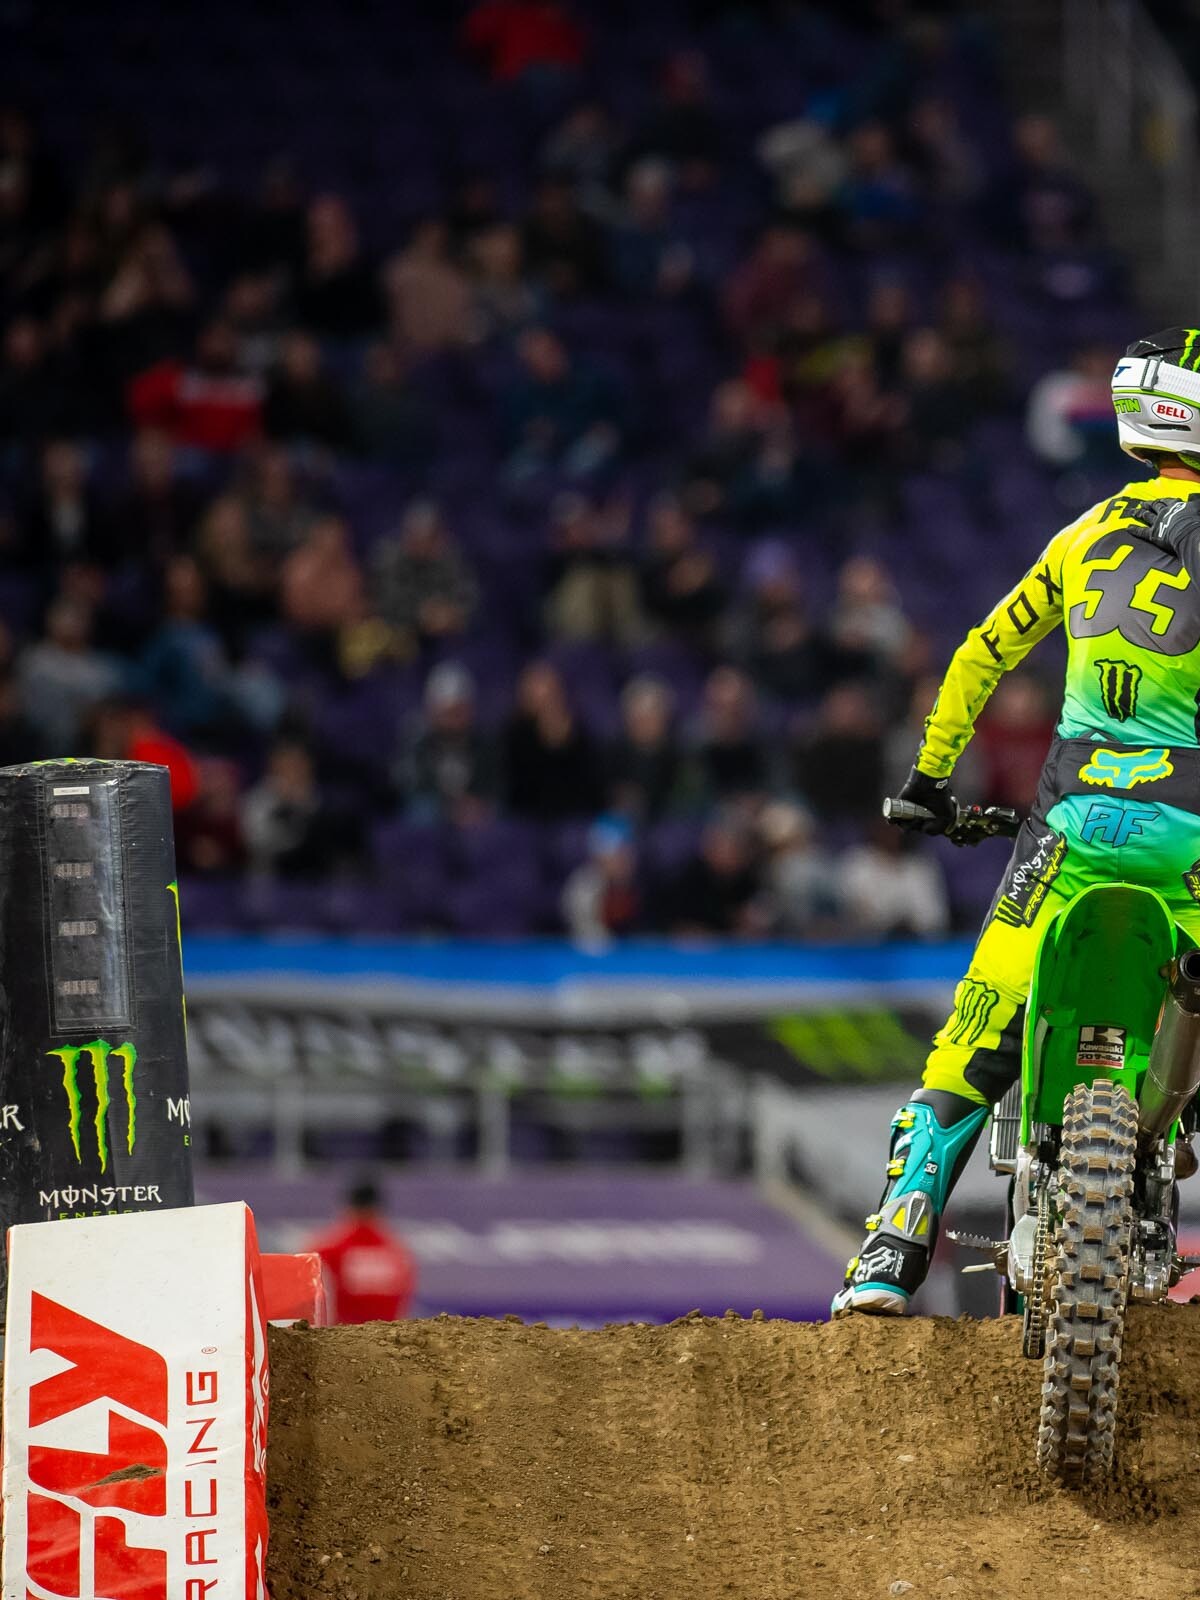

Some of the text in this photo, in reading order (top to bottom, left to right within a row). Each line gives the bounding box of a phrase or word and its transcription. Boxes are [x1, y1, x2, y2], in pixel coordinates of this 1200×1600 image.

[1157, 404, 1187, 419] BELL
[980, 564, 1063, 663] FOX
[1080, 803, 1160, 848] AF
[1079, 1042, 1124, 1055] Kawasaki
[38, 1183, 163, 1209] MONSTER
[185, 1371, 218, 1600] RACING
